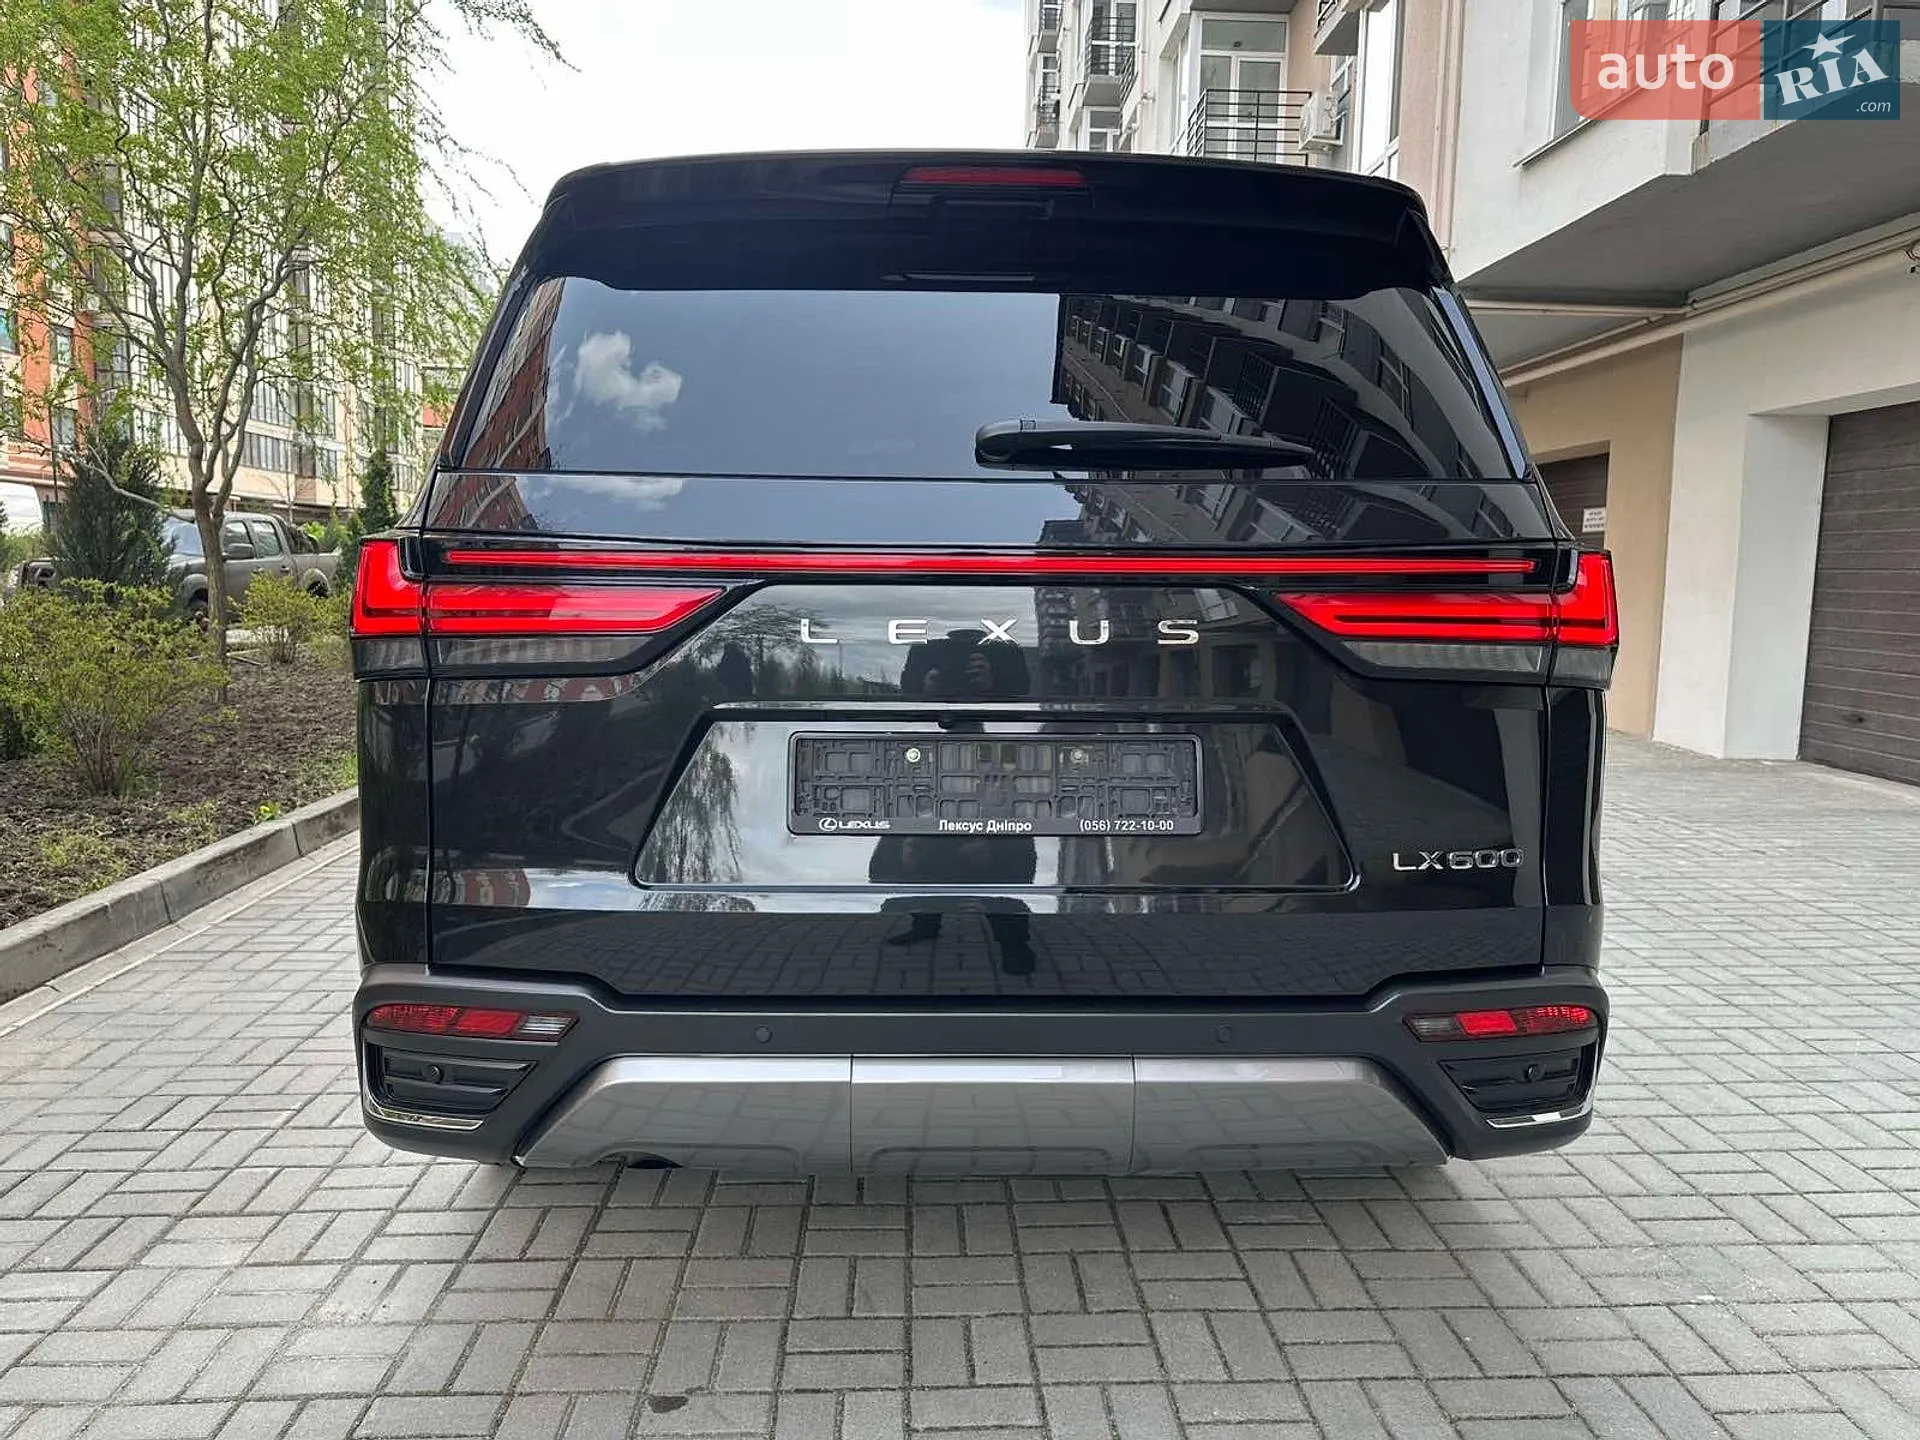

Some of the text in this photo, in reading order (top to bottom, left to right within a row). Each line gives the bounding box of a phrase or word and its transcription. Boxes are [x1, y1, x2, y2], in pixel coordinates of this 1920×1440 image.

[799, 618, 1200, 645] LEXUS
[838, 820, 891, 830] LEXUS
[939, 819, 1033, 833] Лексус Дніпро
[1079, 819, 1174, 832] (056) 722-10-00
[1392, 848, 1524, 871] LX600
